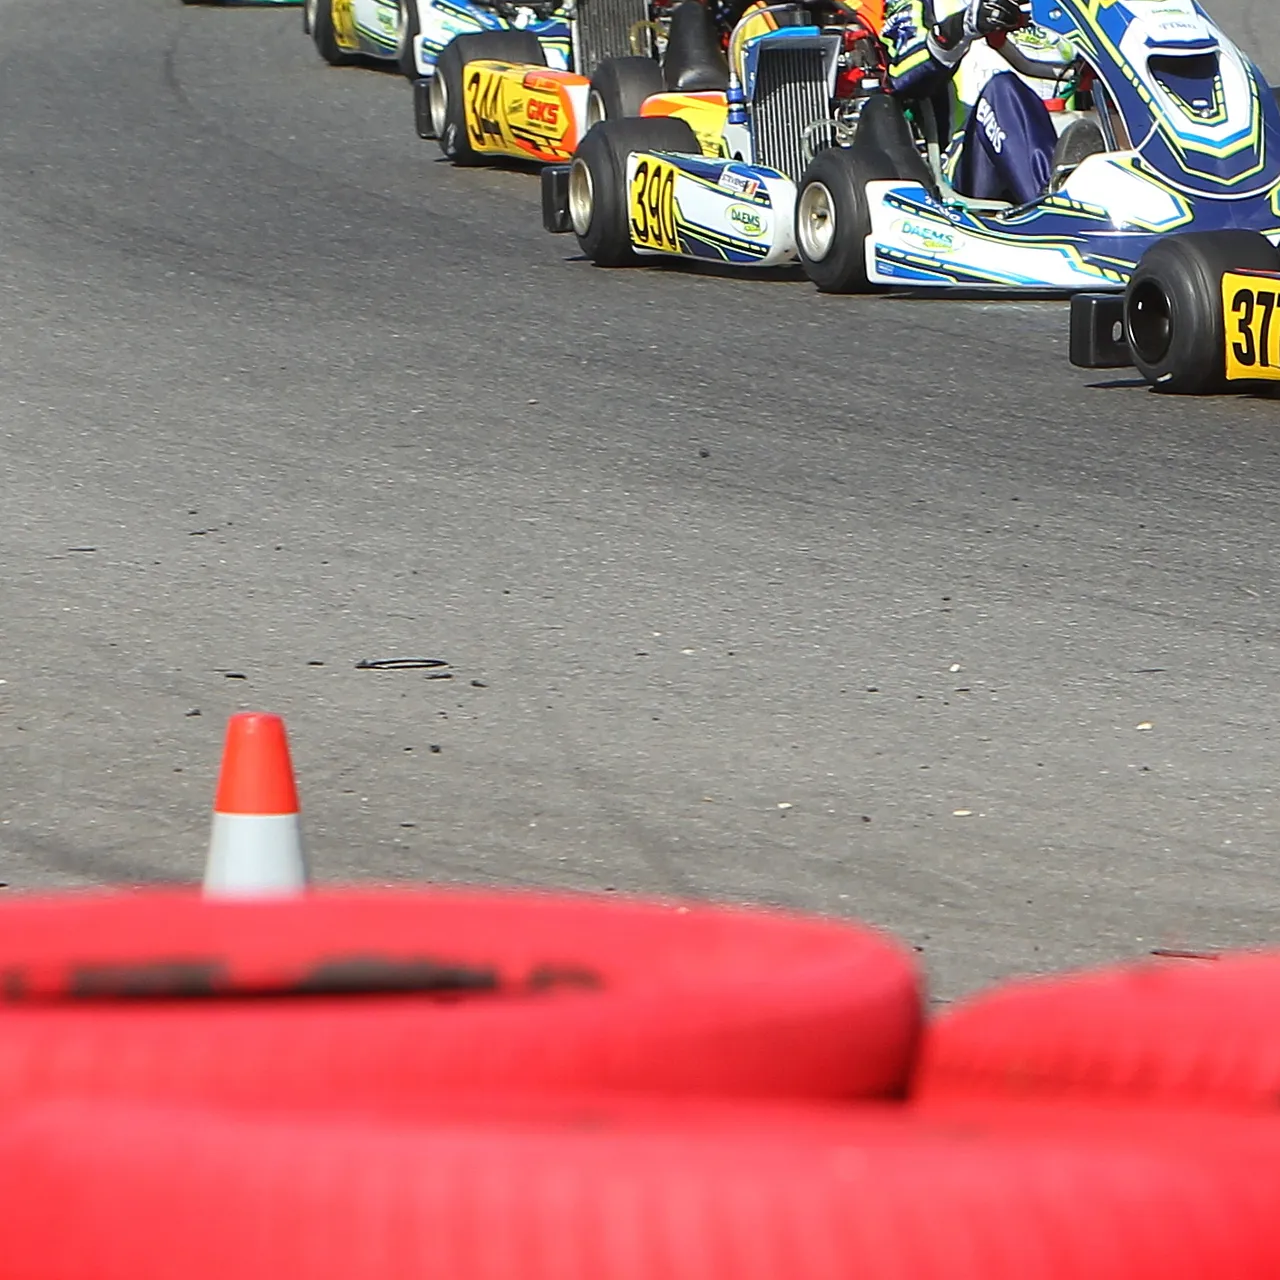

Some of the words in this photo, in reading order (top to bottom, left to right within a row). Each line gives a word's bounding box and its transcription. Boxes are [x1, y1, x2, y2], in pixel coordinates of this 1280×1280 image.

[527, 98, 560, 125] GKS
[633, 161, 676, 250] 390
[731, 208, 760, 228] DAEMS
[901, 221, 955, 243] DAEMS
